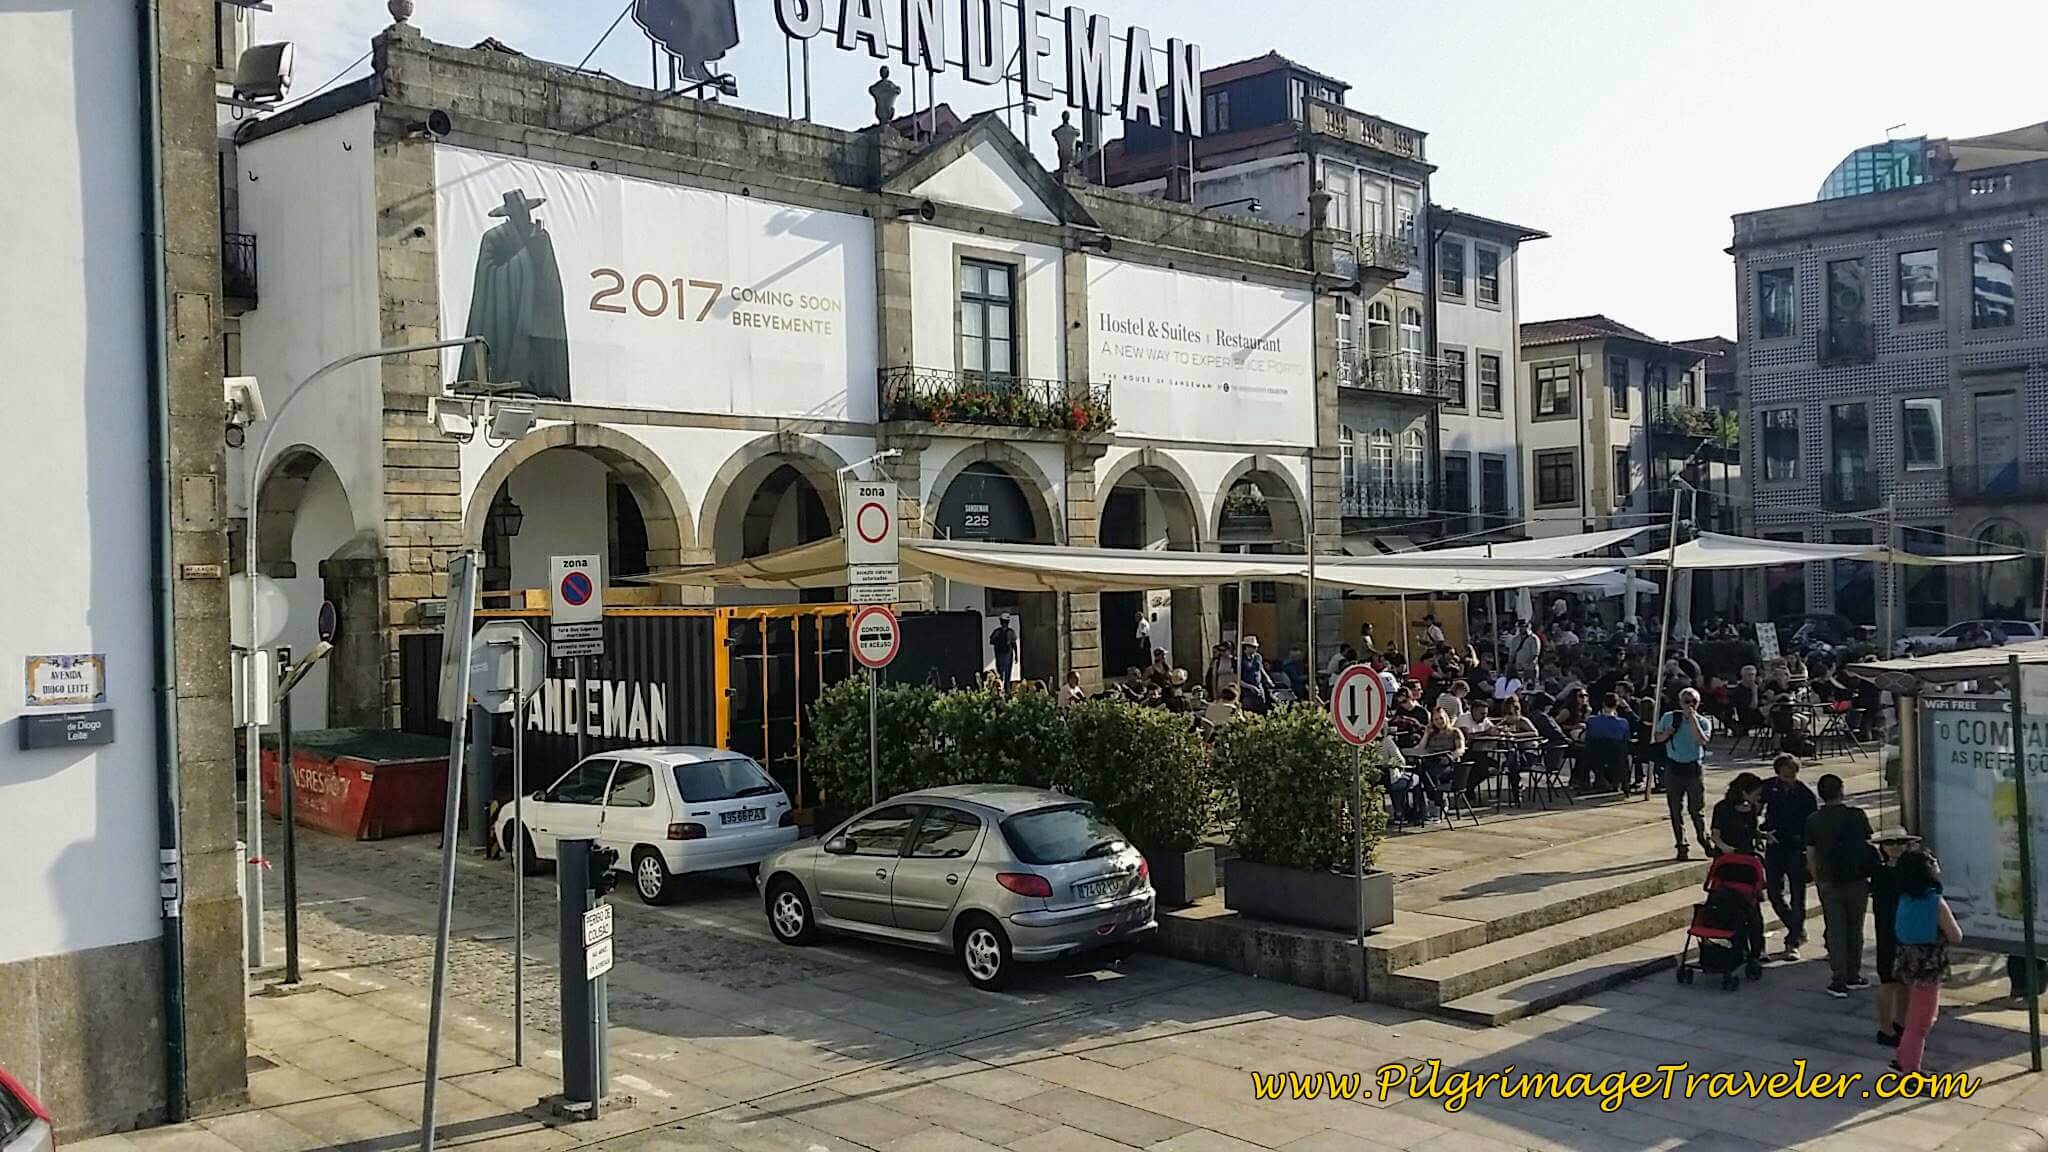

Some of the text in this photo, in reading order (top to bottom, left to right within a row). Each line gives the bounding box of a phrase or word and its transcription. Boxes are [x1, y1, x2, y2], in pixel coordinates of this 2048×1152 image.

[589, 268, 723, 322] 2017
[731, 286, 842, 312] COMING SOON
[732, 311, 832, 336] BREVEMENTE
[1100, 312, 1281, 353] Hostel & Suites Restaurant
[1101, 341, 1113, 354] A
[1114, 344, 1143, 360] NEW
[1146, 347, 1170, 362] WAY
[1174, 350, 1189, 366] TO
[1192, 353, 1265, 373] EXPERIENCE
[859, 488, 885, 497] zona
[965, 515, 990, 527] 225
[563, 559, 588, 568] zona
[861, 625, 890, 633] CONTROLO
[50, 670, 82, 681] AVENIDA
[42, 683, 88, 695] DIOGO LEITE
[1924, 700, 1977, 711] WiFi FREE
[67, 720, 101, 731] de Diogo
[67, 732, 88, 741] Leite
[1940, 719, 2048, 748] O COMA
[1951, 750, 1968, 764] AS
[604, 907, 611, 920] DE
